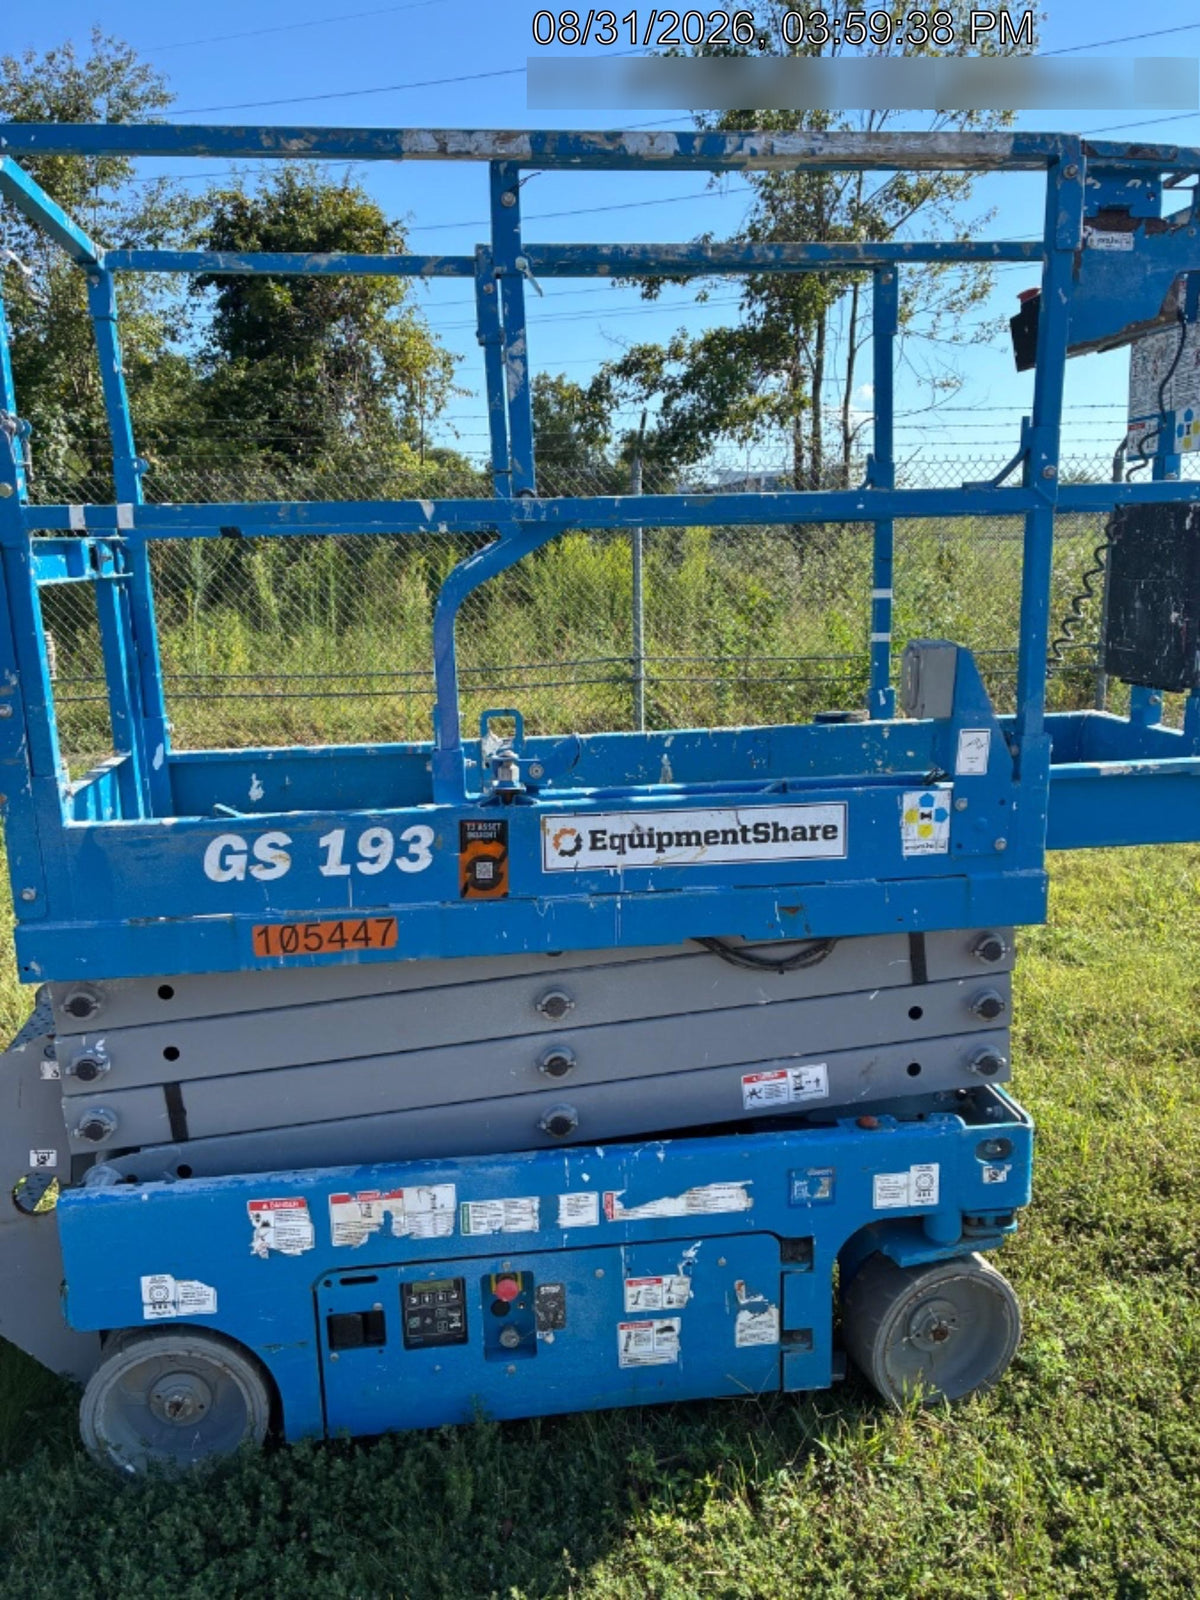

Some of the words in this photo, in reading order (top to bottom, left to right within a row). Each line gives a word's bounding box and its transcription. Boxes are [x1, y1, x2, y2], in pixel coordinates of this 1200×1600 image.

[204, 832, 292, 882] GS
[319, 824, 435, 876] 193
[589, 822, 838, 855] EquipmentShare
[257, 918, 397, 955] 105447
